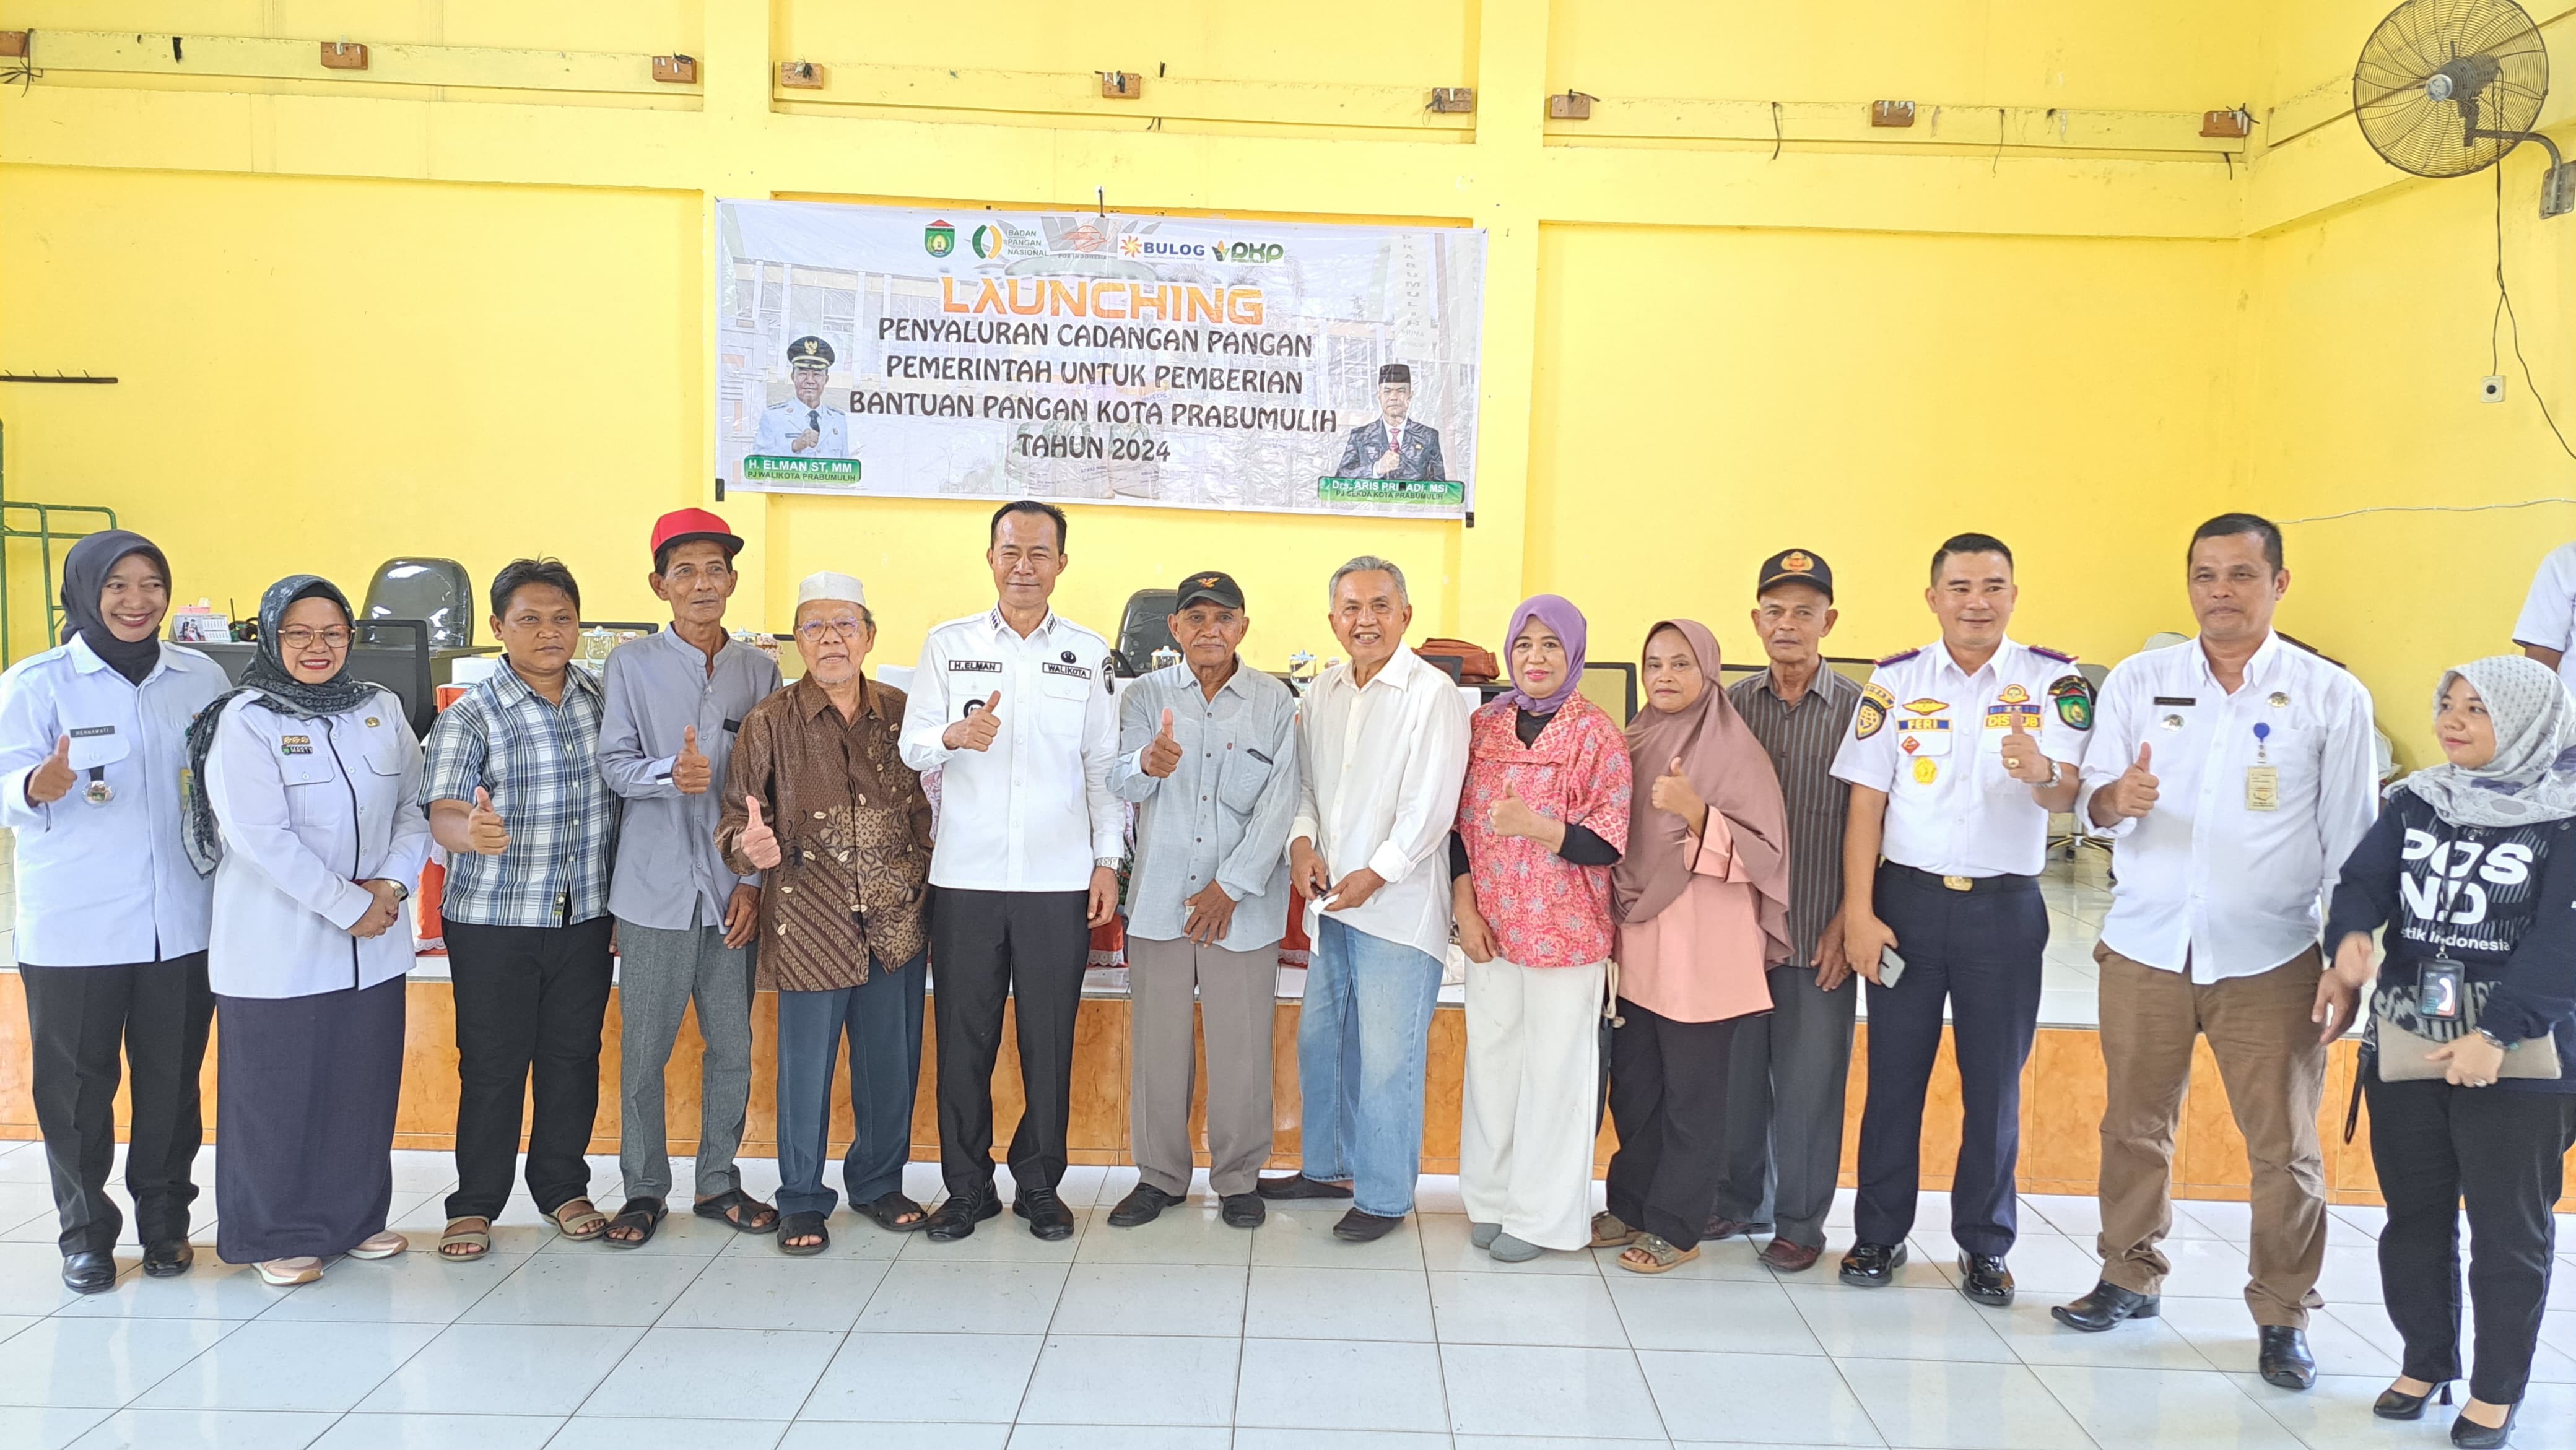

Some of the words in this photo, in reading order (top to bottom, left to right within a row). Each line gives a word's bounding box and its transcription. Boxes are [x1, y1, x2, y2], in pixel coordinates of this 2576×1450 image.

[1144, 242, 1205, 256] BULOG
[941, 276, 1263, 325] LAUNCHING
[879, 317, 1048, 345] PENYALURAN
[1057, 324, 1198, 352] CADANGAN
[1208, 331, 1312, 357] PANGAN
[887, 355, 1051, 383] PEMERINTAH
[1061, 361, 1146, 387] UNTUK
[1155, 365, 1302, 394] PEMBERIAN
[850, 391, 974, 417] BANTUAN
[983, 396, 1088, 421] PANGAN
[1097, 400, 1162, 425] KOTA
[1172, 403, 1336, 432] PRABUMULIH
[1017, 433, 1103, 459] TAHUN
[1112, 438, 1170, 462] 2024
[749, 459, 760, 469] H.
[763, 460, 807, 471] ELMAN
[811, 462, 829, 472] ST,
[832, 463, 852, 472] MM
[803, 474, 856, 482] PRABUMULIH
[1354, 482, 1379, 491] ARIS
[1048, 664, 1087, 677] WALIKOTA
[1909, 720, 1938, 729] FERI
[1988, 716, 2039, 726] DISUB
[2399, 872, 2487, 925] ND
[2429, 931, 2510, 952] Indonesia
